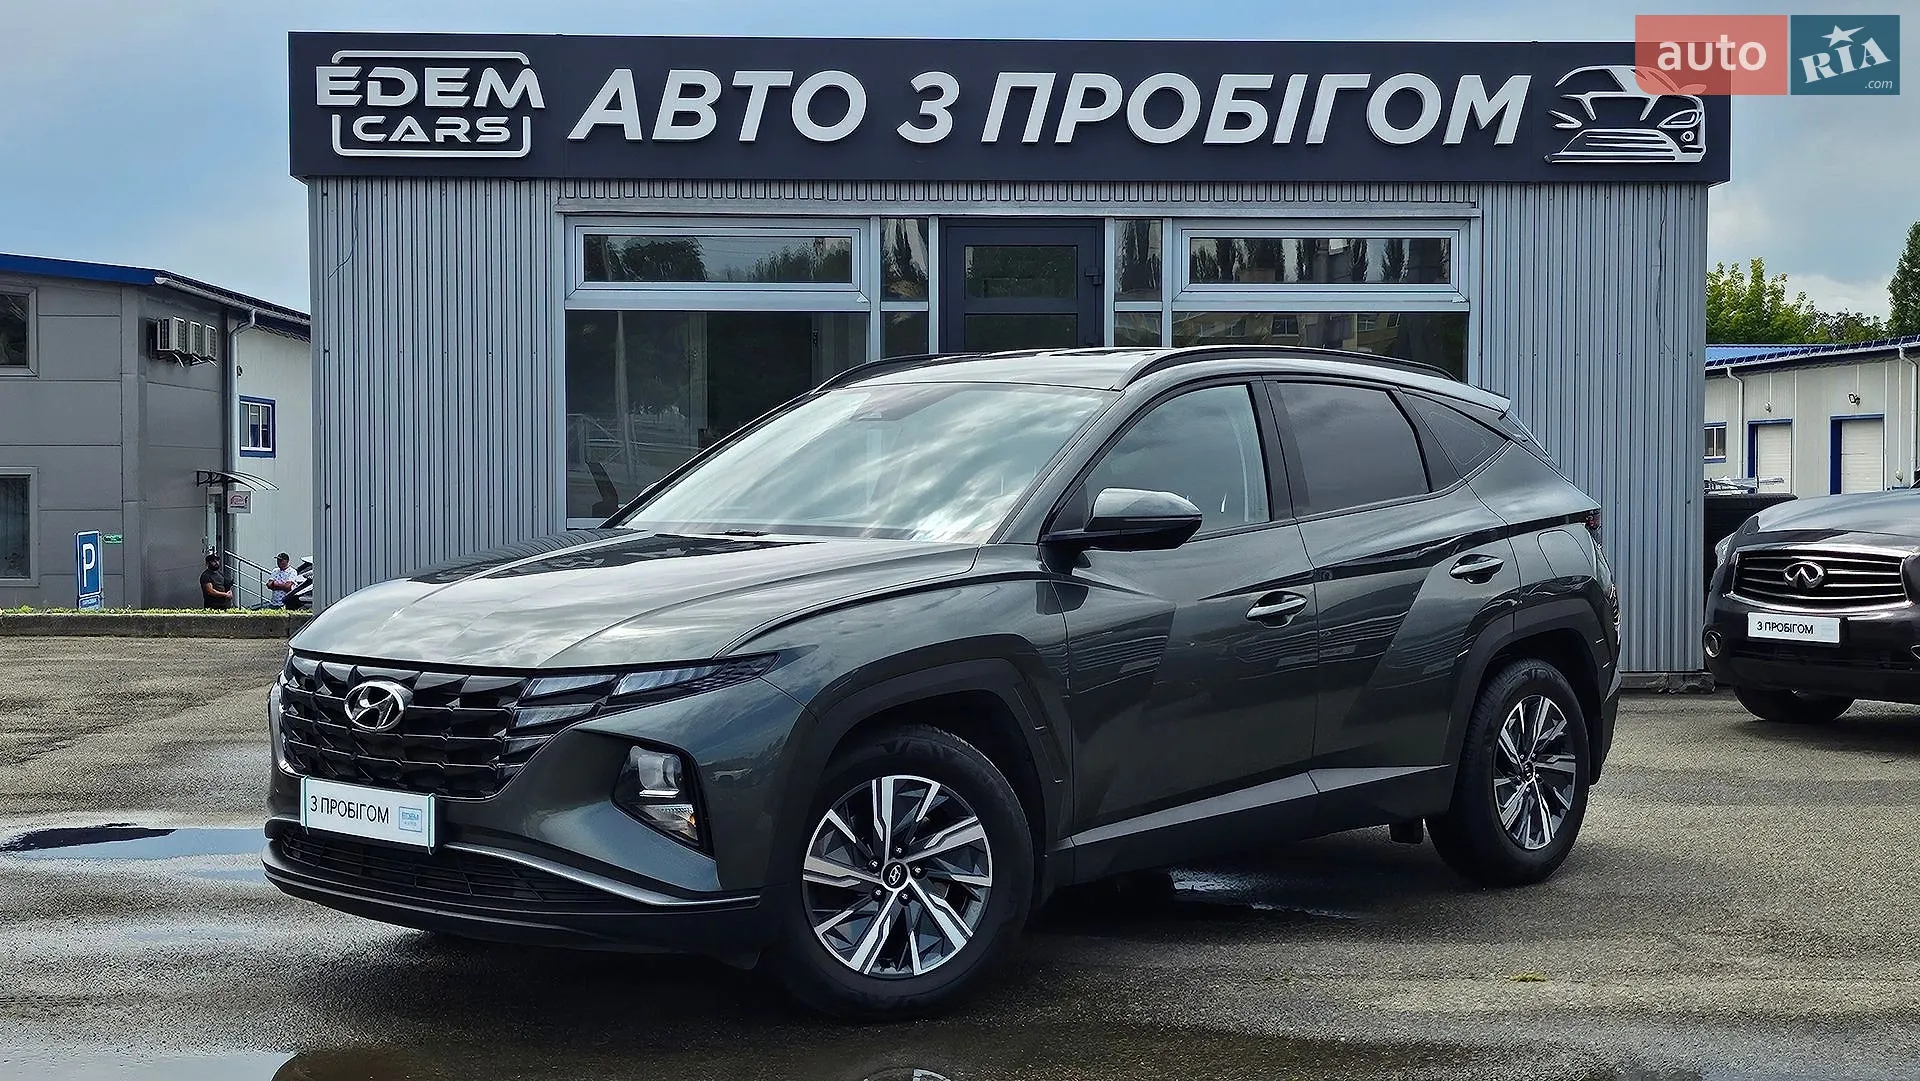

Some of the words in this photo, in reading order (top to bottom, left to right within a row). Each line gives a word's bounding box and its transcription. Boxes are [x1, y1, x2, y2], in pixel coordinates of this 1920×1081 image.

[316, 66, 545, 108] EDEM
[568, 69, 867, 142] АВТО
[981, 72, 1531, 145] ПРОБІГОМ
[353, 116, 511, 143] CARS
[1764, 622, 1814, 634] ПРОБІГОМ
[321, 797, 389, 824] ПРОБІГОМ
